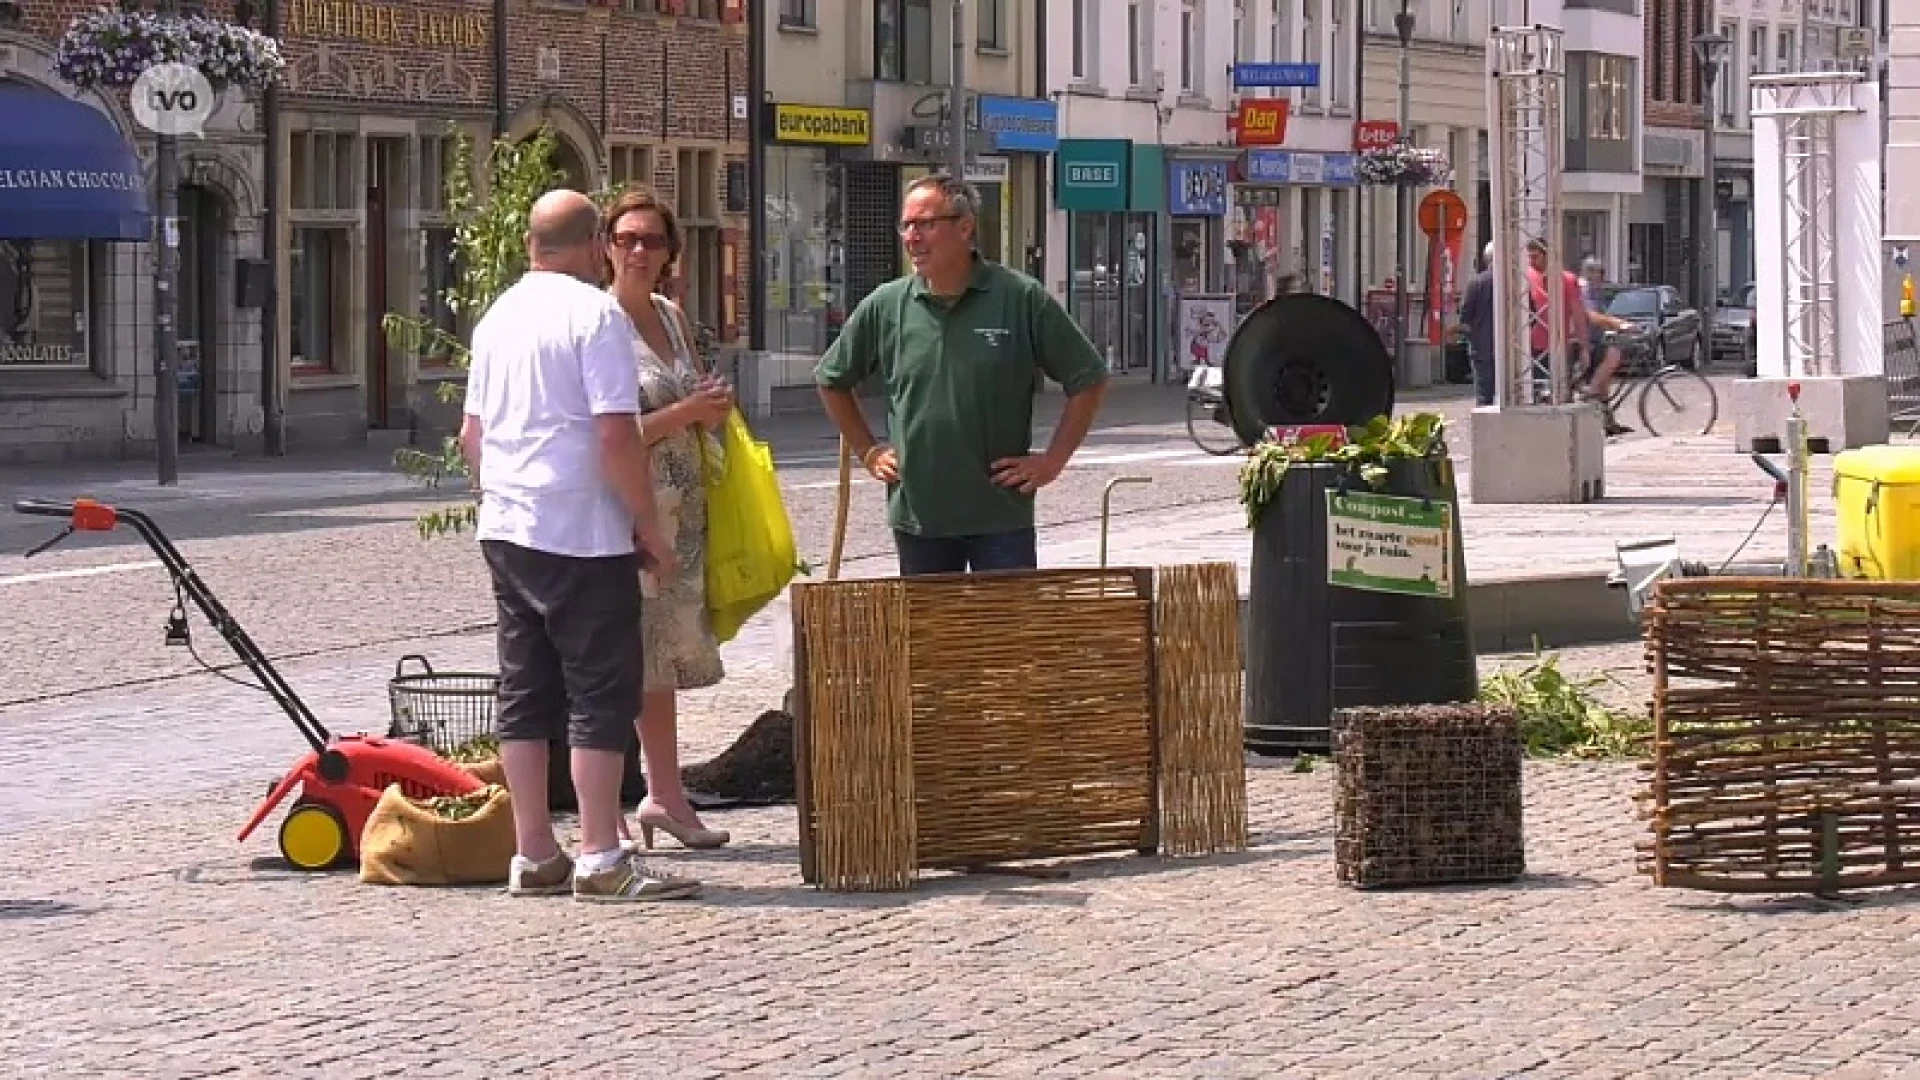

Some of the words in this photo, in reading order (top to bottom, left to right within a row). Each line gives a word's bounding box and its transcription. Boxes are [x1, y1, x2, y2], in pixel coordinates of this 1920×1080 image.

[780, 112, 866, 137] europabank
[1072, 167, 1112, 181] BASE
[1333, 496, 1405, 519] Compost
